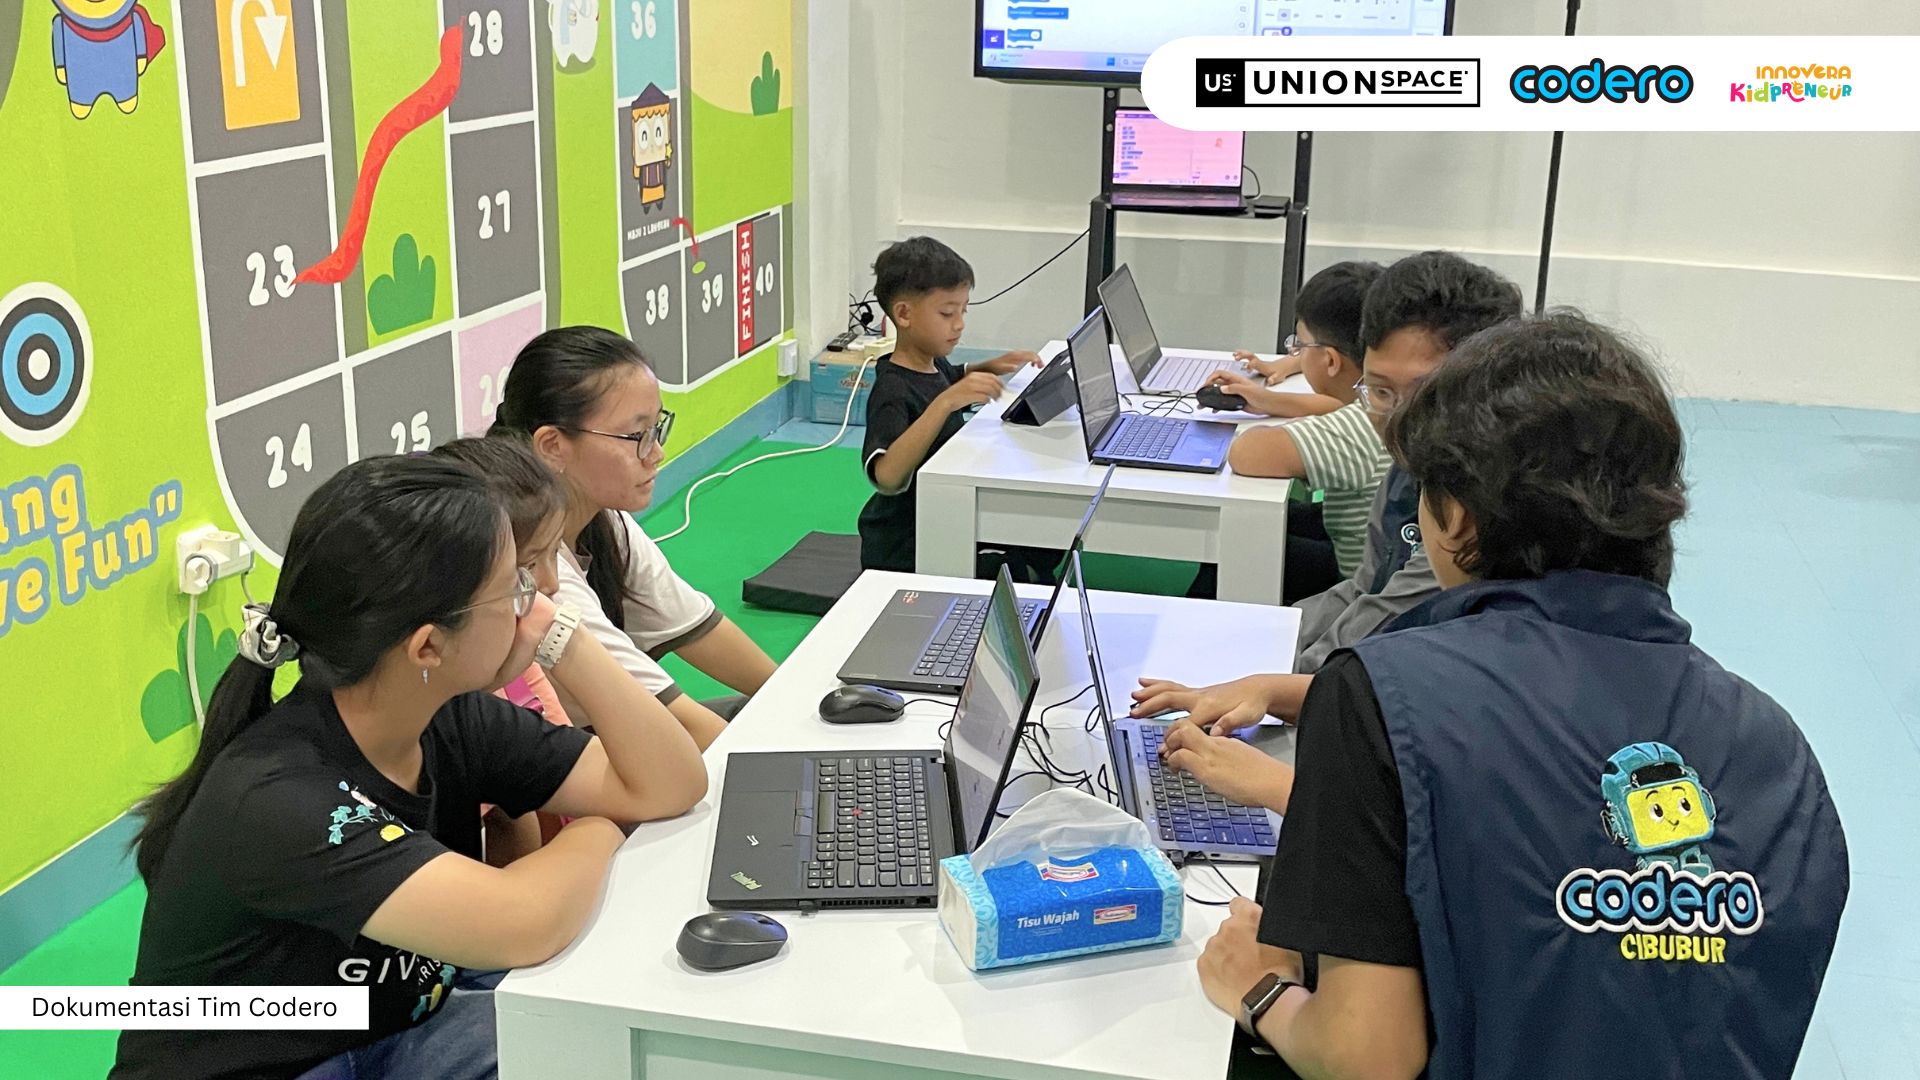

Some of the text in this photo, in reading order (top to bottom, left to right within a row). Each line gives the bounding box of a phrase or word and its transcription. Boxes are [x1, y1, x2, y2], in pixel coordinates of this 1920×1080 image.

[468, 9, 504, 57] 28
[631, 0, 657, 41] 36
[477, 189, 511, 239] 27
[246, 244, 297, 306] 23
[701, 273, 723, 313] 39
[741, 230, 752, 342] FINISH
[755, 262, 774, 297] 40
[645, 284, 669, 325] 38
[391, 410, 431, 455] 25
[265, 422, 313, 489] 24
[1017, 909, 1080, 929] Tisu Wajah
[1561, 866, 1759, 928] codero
[1620, 933, 1727, 963] CIBUBUR
